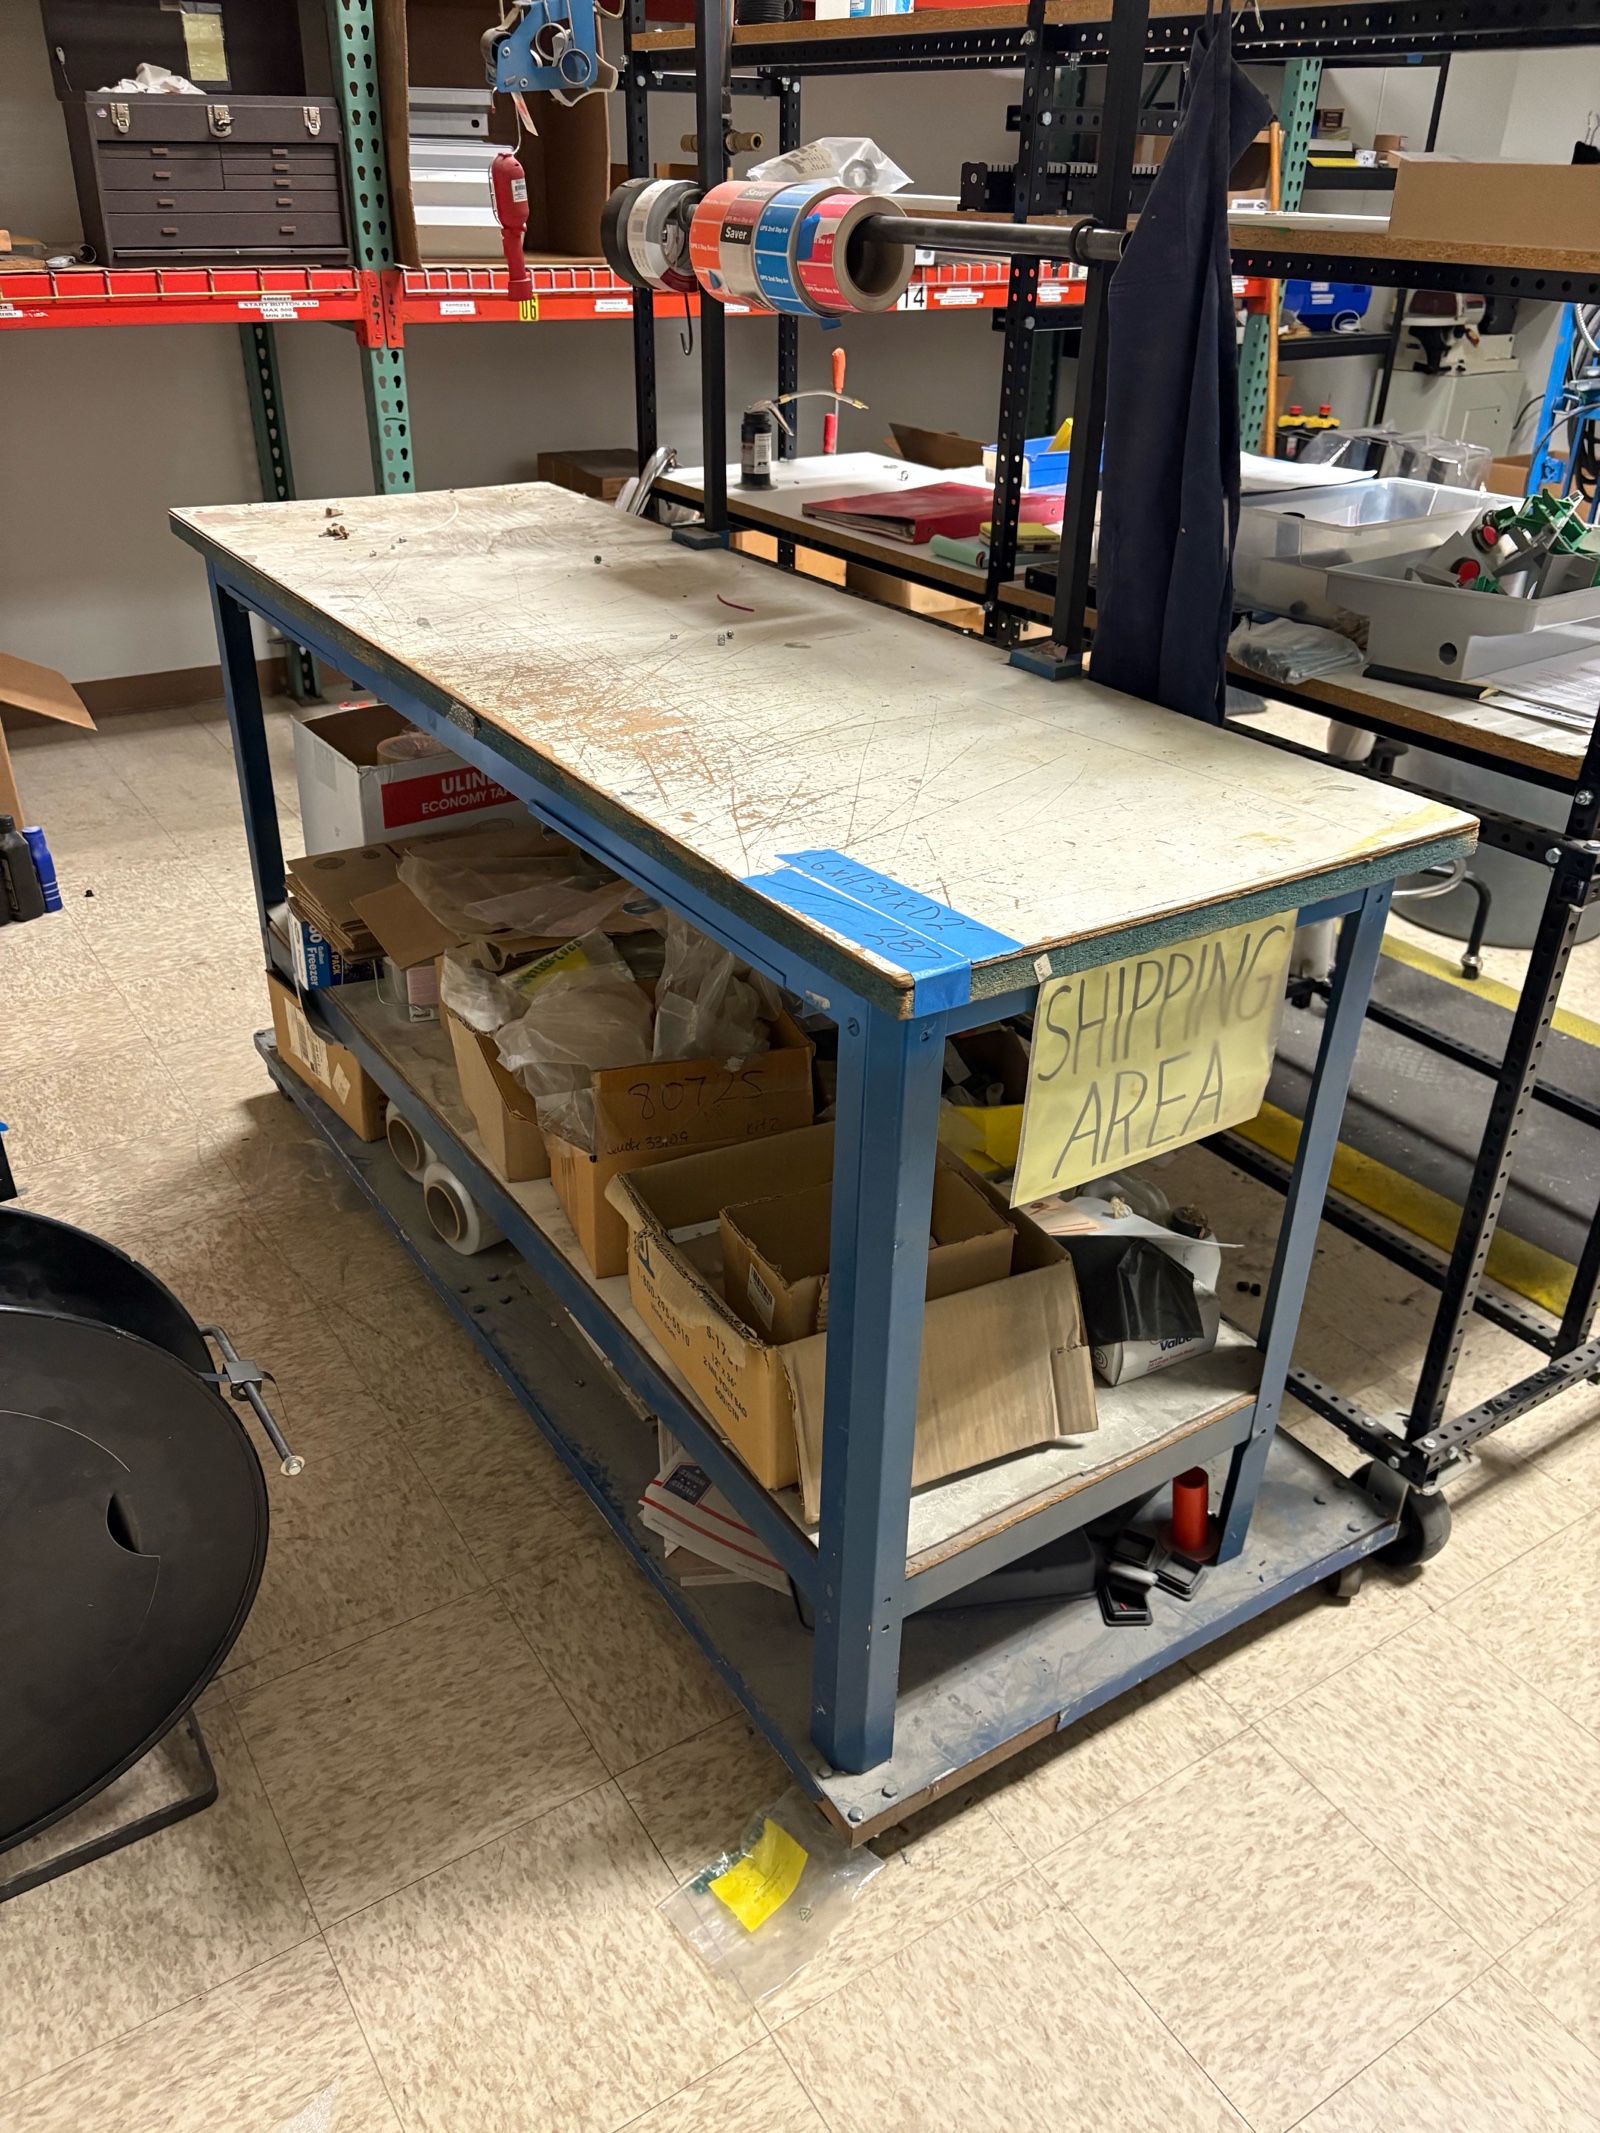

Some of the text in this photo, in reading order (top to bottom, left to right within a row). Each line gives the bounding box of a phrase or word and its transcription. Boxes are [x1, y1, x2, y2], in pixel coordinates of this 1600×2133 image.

[725, 226, 748, 240] Saver
[904, 286, 925, 308] 14
[422, 788, 512, 814] ECONOMY TAP
[864, 928, 942, 958] 287
[306, 946, 319, 986] Freezer
[332, 954, 341, 975] PACK
[1037, 924, 1286, 1082] SHIPPING
[1052, 1039, 1224, 1180] AREA
[637, 1266, 690, 1347] 1-800-295-5510
[719, 1376, 734, 1400] POLY
[734, 1396, 747, 1417] BAG
[670, 1480, 697, 1498] TRACKED
